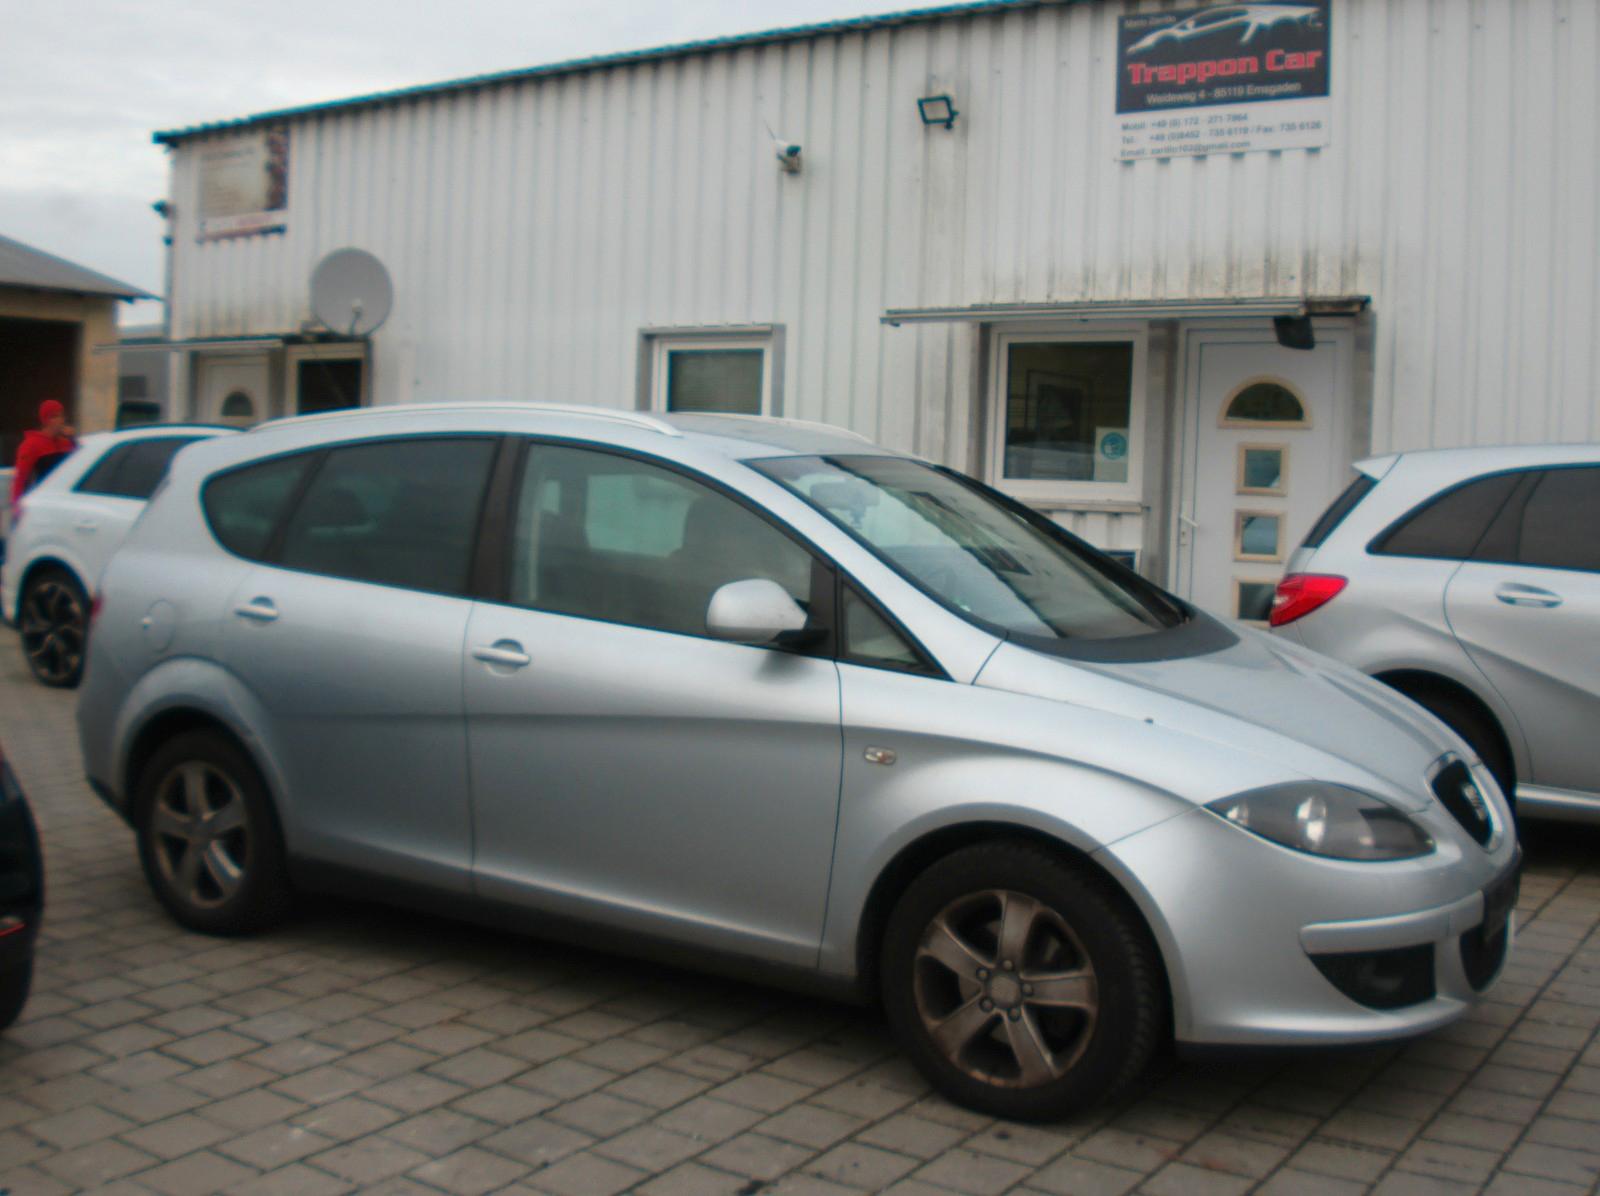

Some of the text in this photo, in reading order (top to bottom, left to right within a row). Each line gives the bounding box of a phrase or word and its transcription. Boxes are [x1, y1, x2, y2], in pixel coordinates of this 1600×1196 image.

[1127, 48, 1323, 85] Trappon Car
[1198, 89, 1206, 99] 4
[1184, 116, 1200, 126] 172
[1207, 115, 1223, 125] 271
